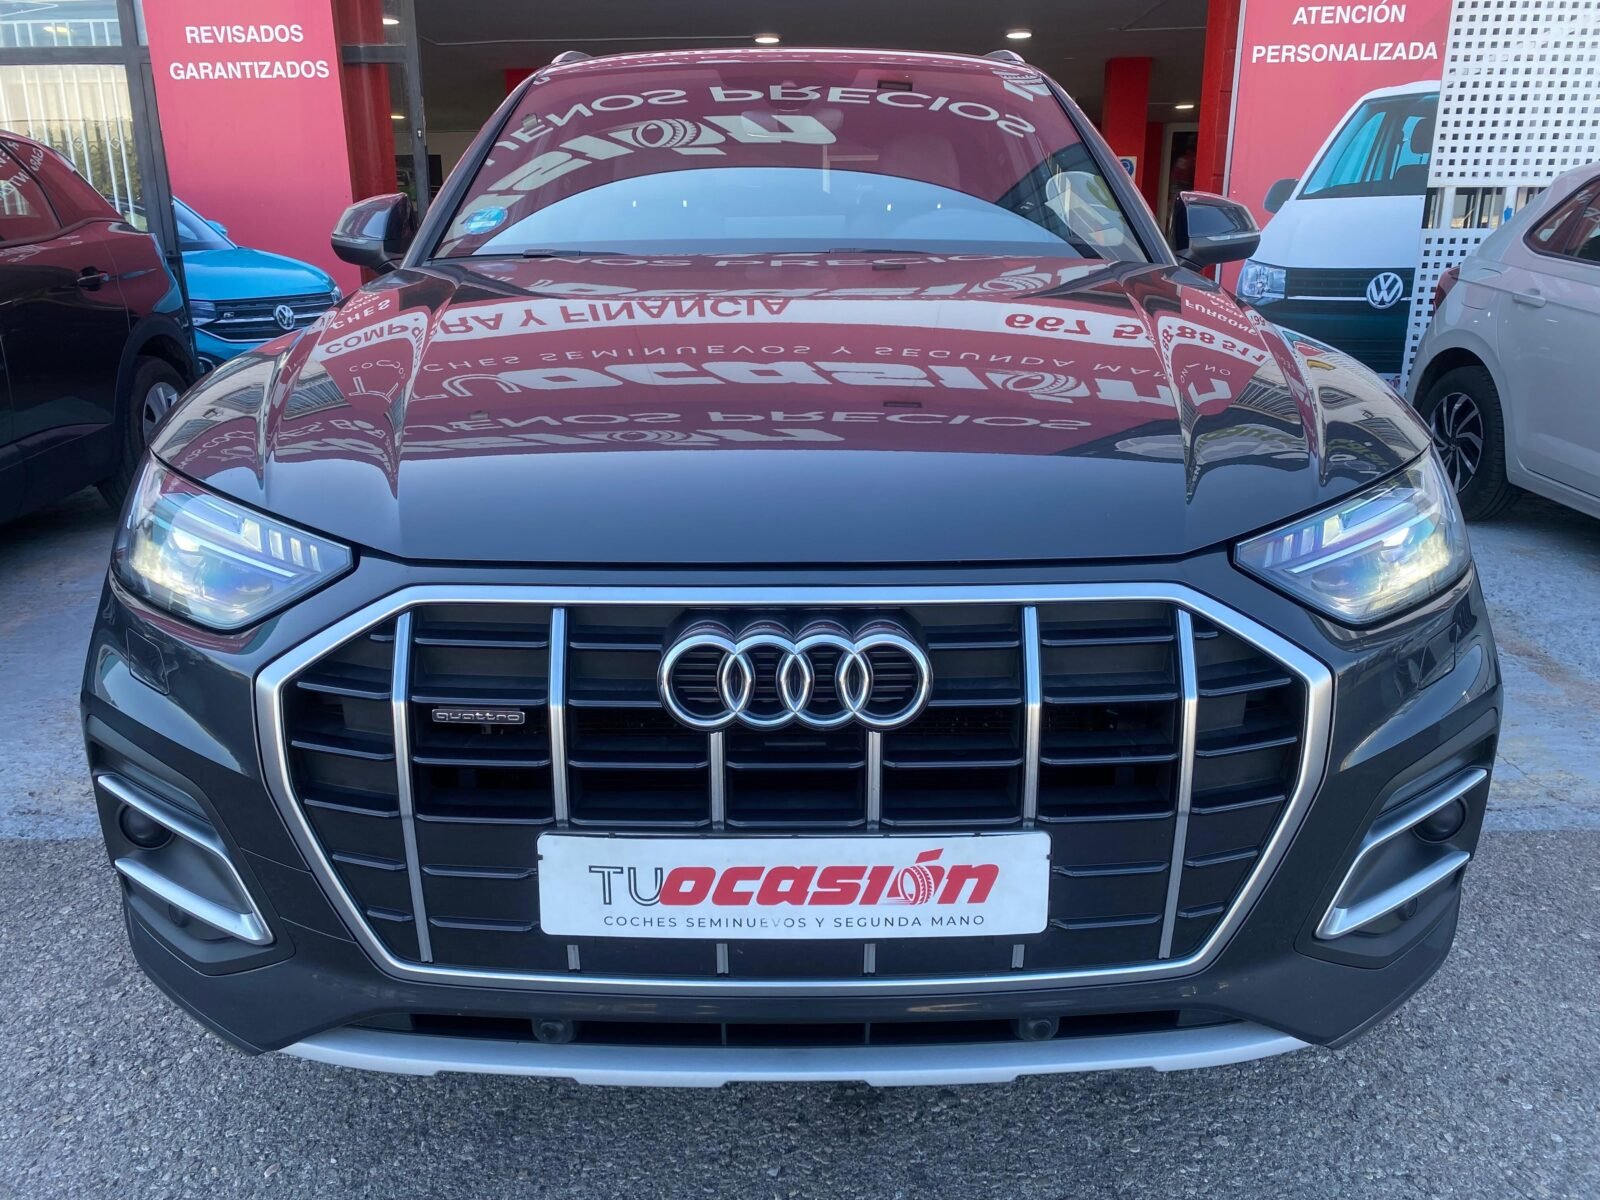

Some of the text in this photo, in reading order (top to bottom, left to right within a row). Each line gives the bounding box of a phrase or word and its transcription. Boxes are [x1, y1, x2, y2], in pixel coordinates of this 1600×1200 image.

[1292, 0, 1406, 25] ATENCIÓN
[185, 24, 304, 44] REVISADOS
[1252, 42, 1438, 63] PERSONALIZADA
[169, 60, 329, 80] GARANTIZADOS
[434, 711, 521, 722] quattro
[603, 914, 985, 929] COCHES SEMINUEVOS Y SEGUNDA MANO
